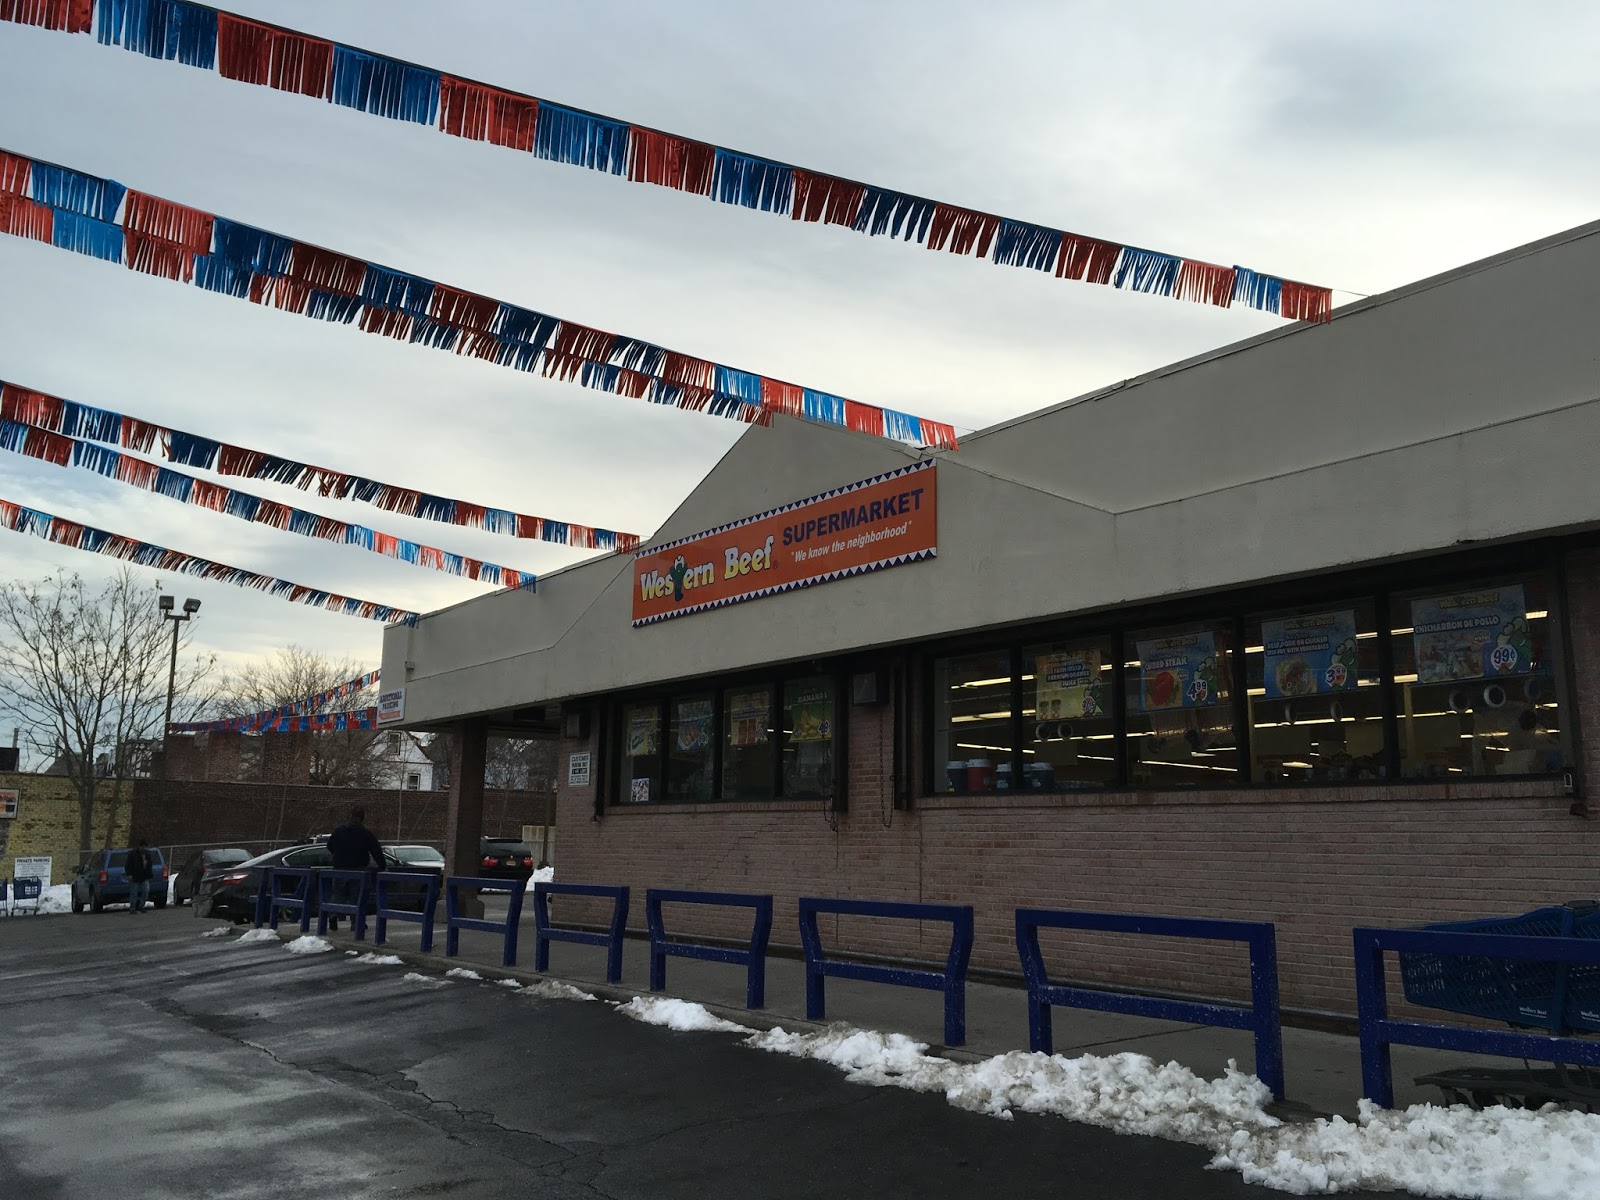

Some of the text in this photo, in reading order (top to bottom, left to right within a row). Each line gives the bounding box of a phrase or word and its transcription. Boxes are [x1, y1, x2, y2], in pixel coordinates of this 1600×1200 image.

[783, 488, 924, 546] SUPERMARKET
[808, 545, 830, 560] know
[832, 539, 845, 553] the
[640, 535, 775, 602] Western Beef
[1464, 620, 1473, 628] DE
[1474, 616, 1499, 627] POLLO
[1165, 656, 1188, 668] STEAK
[1493, 647, 1516, 665] 99¢
[1062, 679, 1077, 687] JUICE
